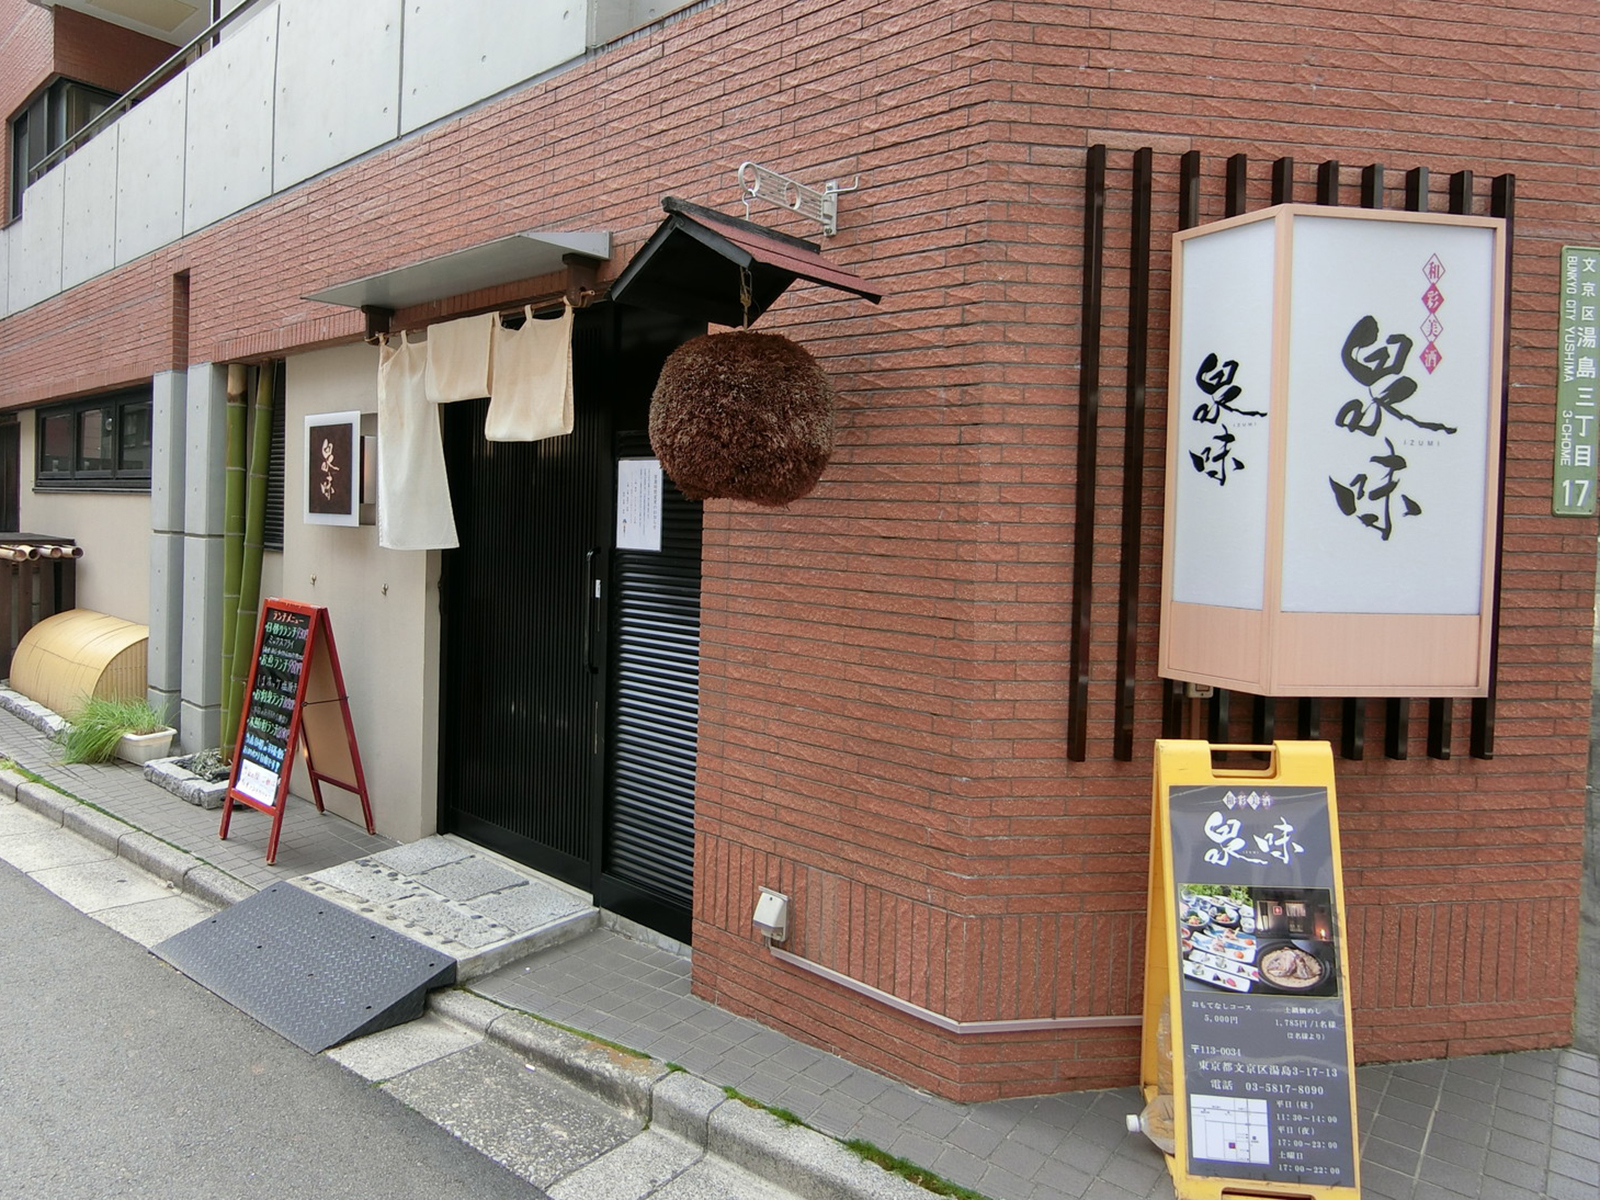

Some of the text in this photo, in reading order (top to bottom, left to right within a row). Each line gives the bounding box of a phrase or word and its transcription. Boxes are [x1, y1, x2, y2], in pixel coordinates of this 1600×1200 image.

[1424, 258, 1443, 369] 和彩美酒
[1560, 255, 1578, 466] BUNKYO CITY YUSHIMA 3-CHOME
[1403, 439, 1441, 447] IZUMI
[1562, 480, 1590, 506] 17
[1191, 1001, 1252, 1011] おもてなしコース
[1204, 1014, 1238, 1024] 5,000円
[1210, 1079, 1324, 1095] 電話 03-5817-8090
[1278, 1151, 1303, 1161] 土曜日
